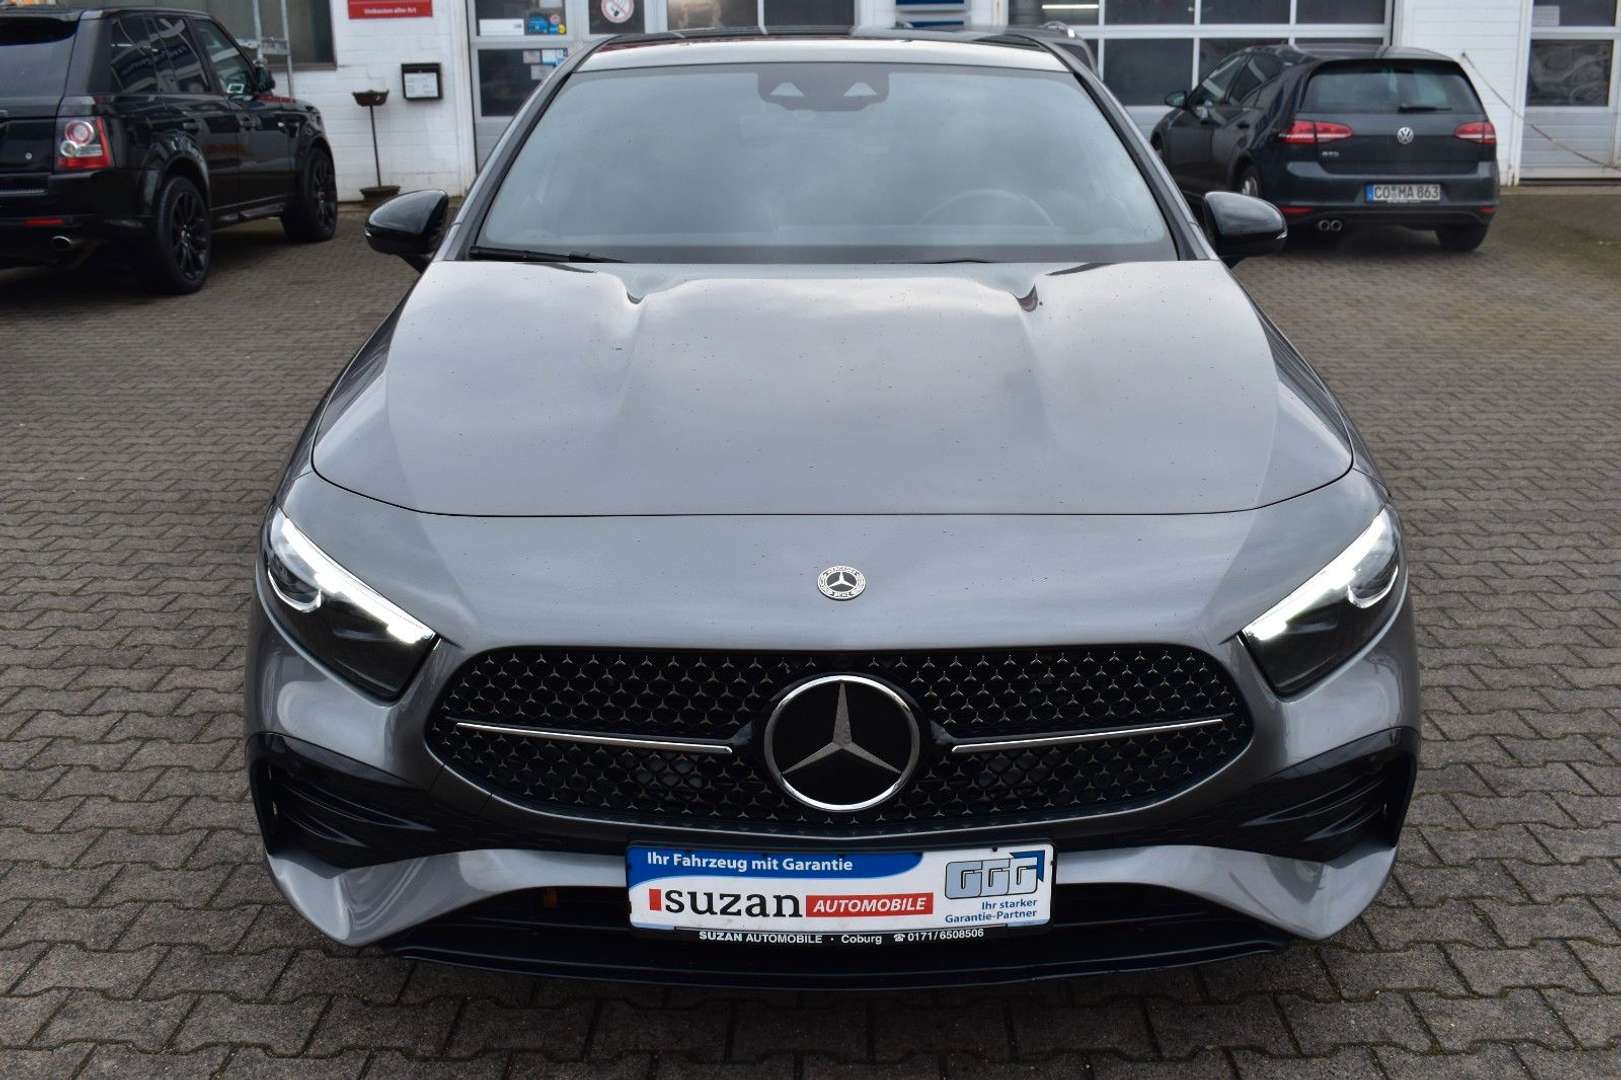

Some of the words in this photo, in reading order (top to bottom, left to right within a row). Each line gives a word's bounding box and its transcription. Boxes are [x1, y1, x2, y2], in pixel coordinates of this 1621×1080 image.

[1375, 186, 1391, 199] CO
[1399, 186, 1414, 199] MA
[1416, 186, 1439, 199] 863
[647, 851, 670, 866] Ihr
[673, 853, 748, 873] Fahrzeug
[751, 857, 779, 871] mit
[782, 858, 853, 872] Garantie
[664, 889, 803, 918] suzan
[812, 897, 927, 913] AUTOMOBILE
[982, 901, 997, 910] Ihr
[999, 898, 1037, 909] starker
[945, 910, 1037, 923] Garantie-Partner
[699, 931, 743, 942] SUZAN
[745, 933, 823, 944] AUTOMOBILE
[841, 934, 882, 945] Coburg
[907, 928, 984, 942] 0171/6508506
